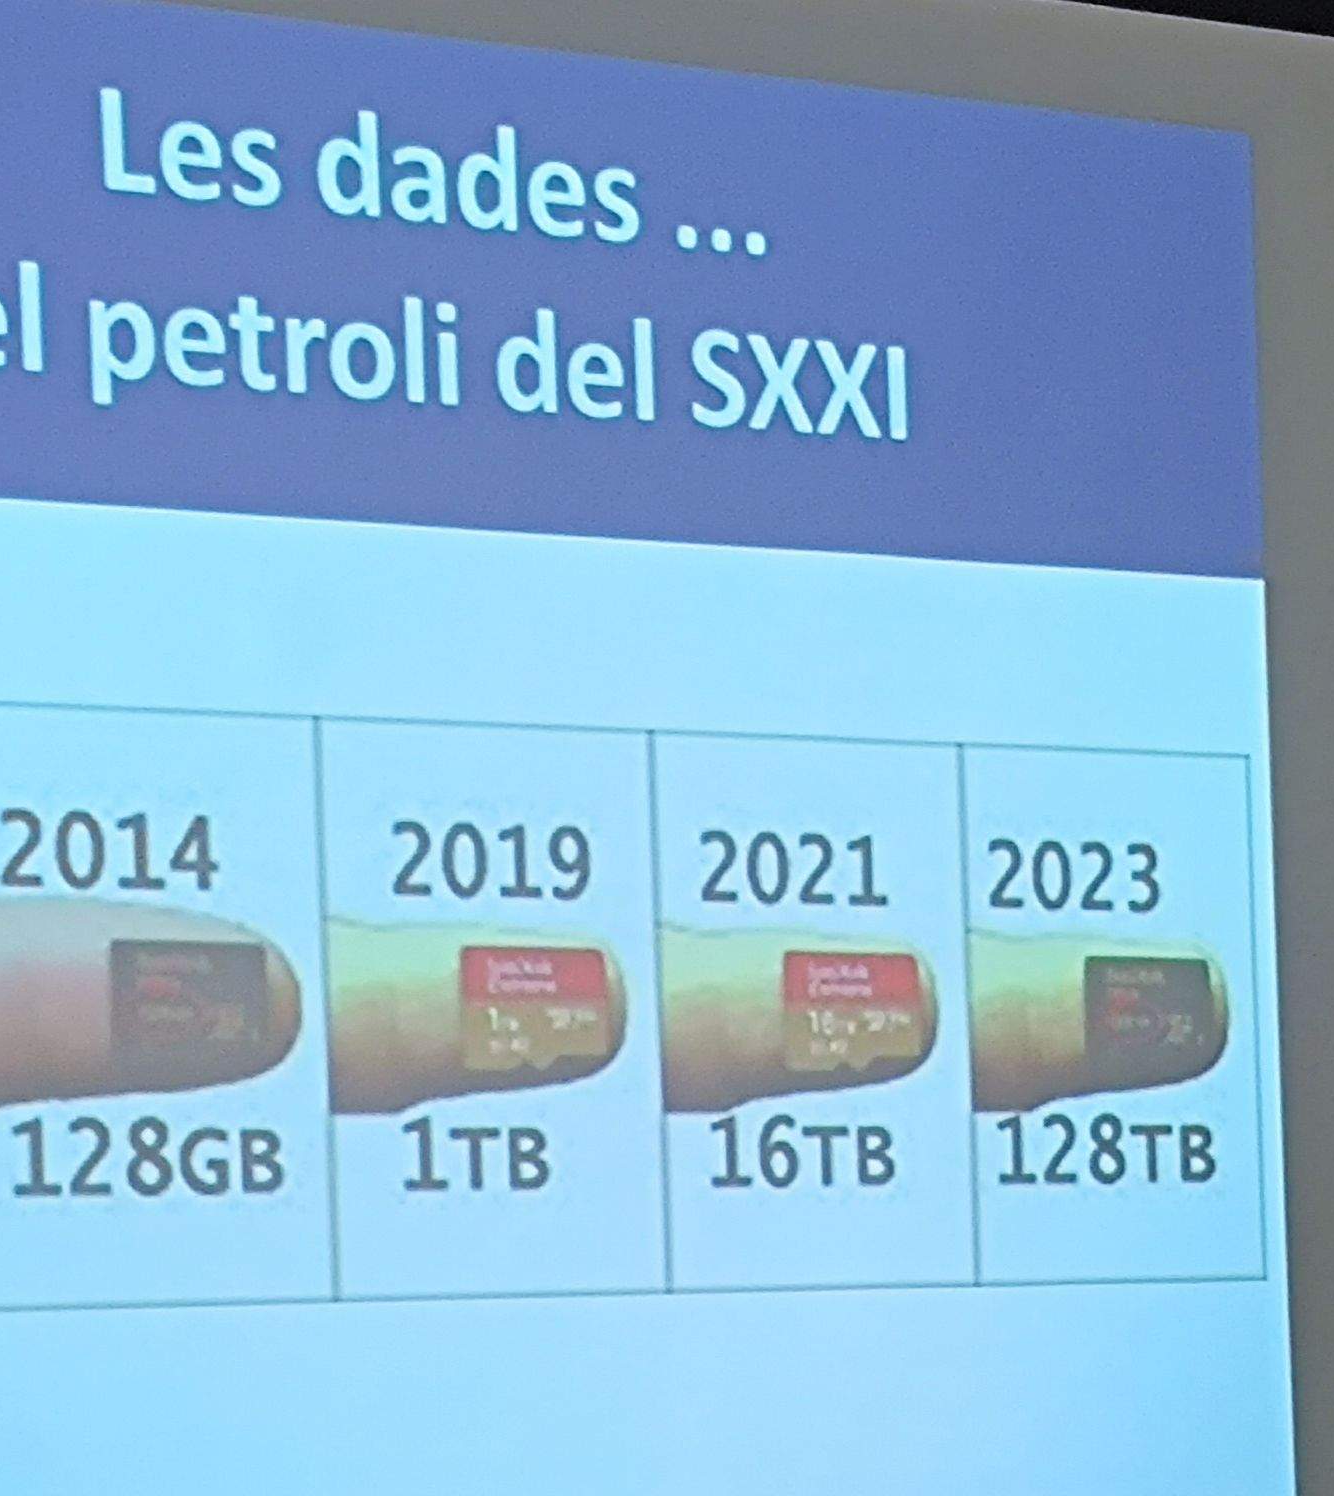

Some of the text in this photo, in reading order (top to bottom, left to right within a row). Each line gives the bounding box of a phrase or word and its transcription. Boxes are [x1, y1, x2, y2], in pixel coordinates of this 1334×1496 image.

[100, 87, 282, 207] Les
[317, 109, 640, 244] dades
[87, 295, 460, 406] petroli
[495, 307, 656, 421] del
[689, 328, 907, 441] SXXI
[0, 807, 220, 891] 2014
[391, 820, 591, 901] 2019
[699, 830, 889, 906] 2021
[987, 840, 1161, 912] 2023
[12, 1116, 285, 1198] 128GB
[403, 1115, 551, 1192] 1TB
[710, 1114, 896, 1189] 16TB
[998, 1114, 1217, 1186] 128TB
